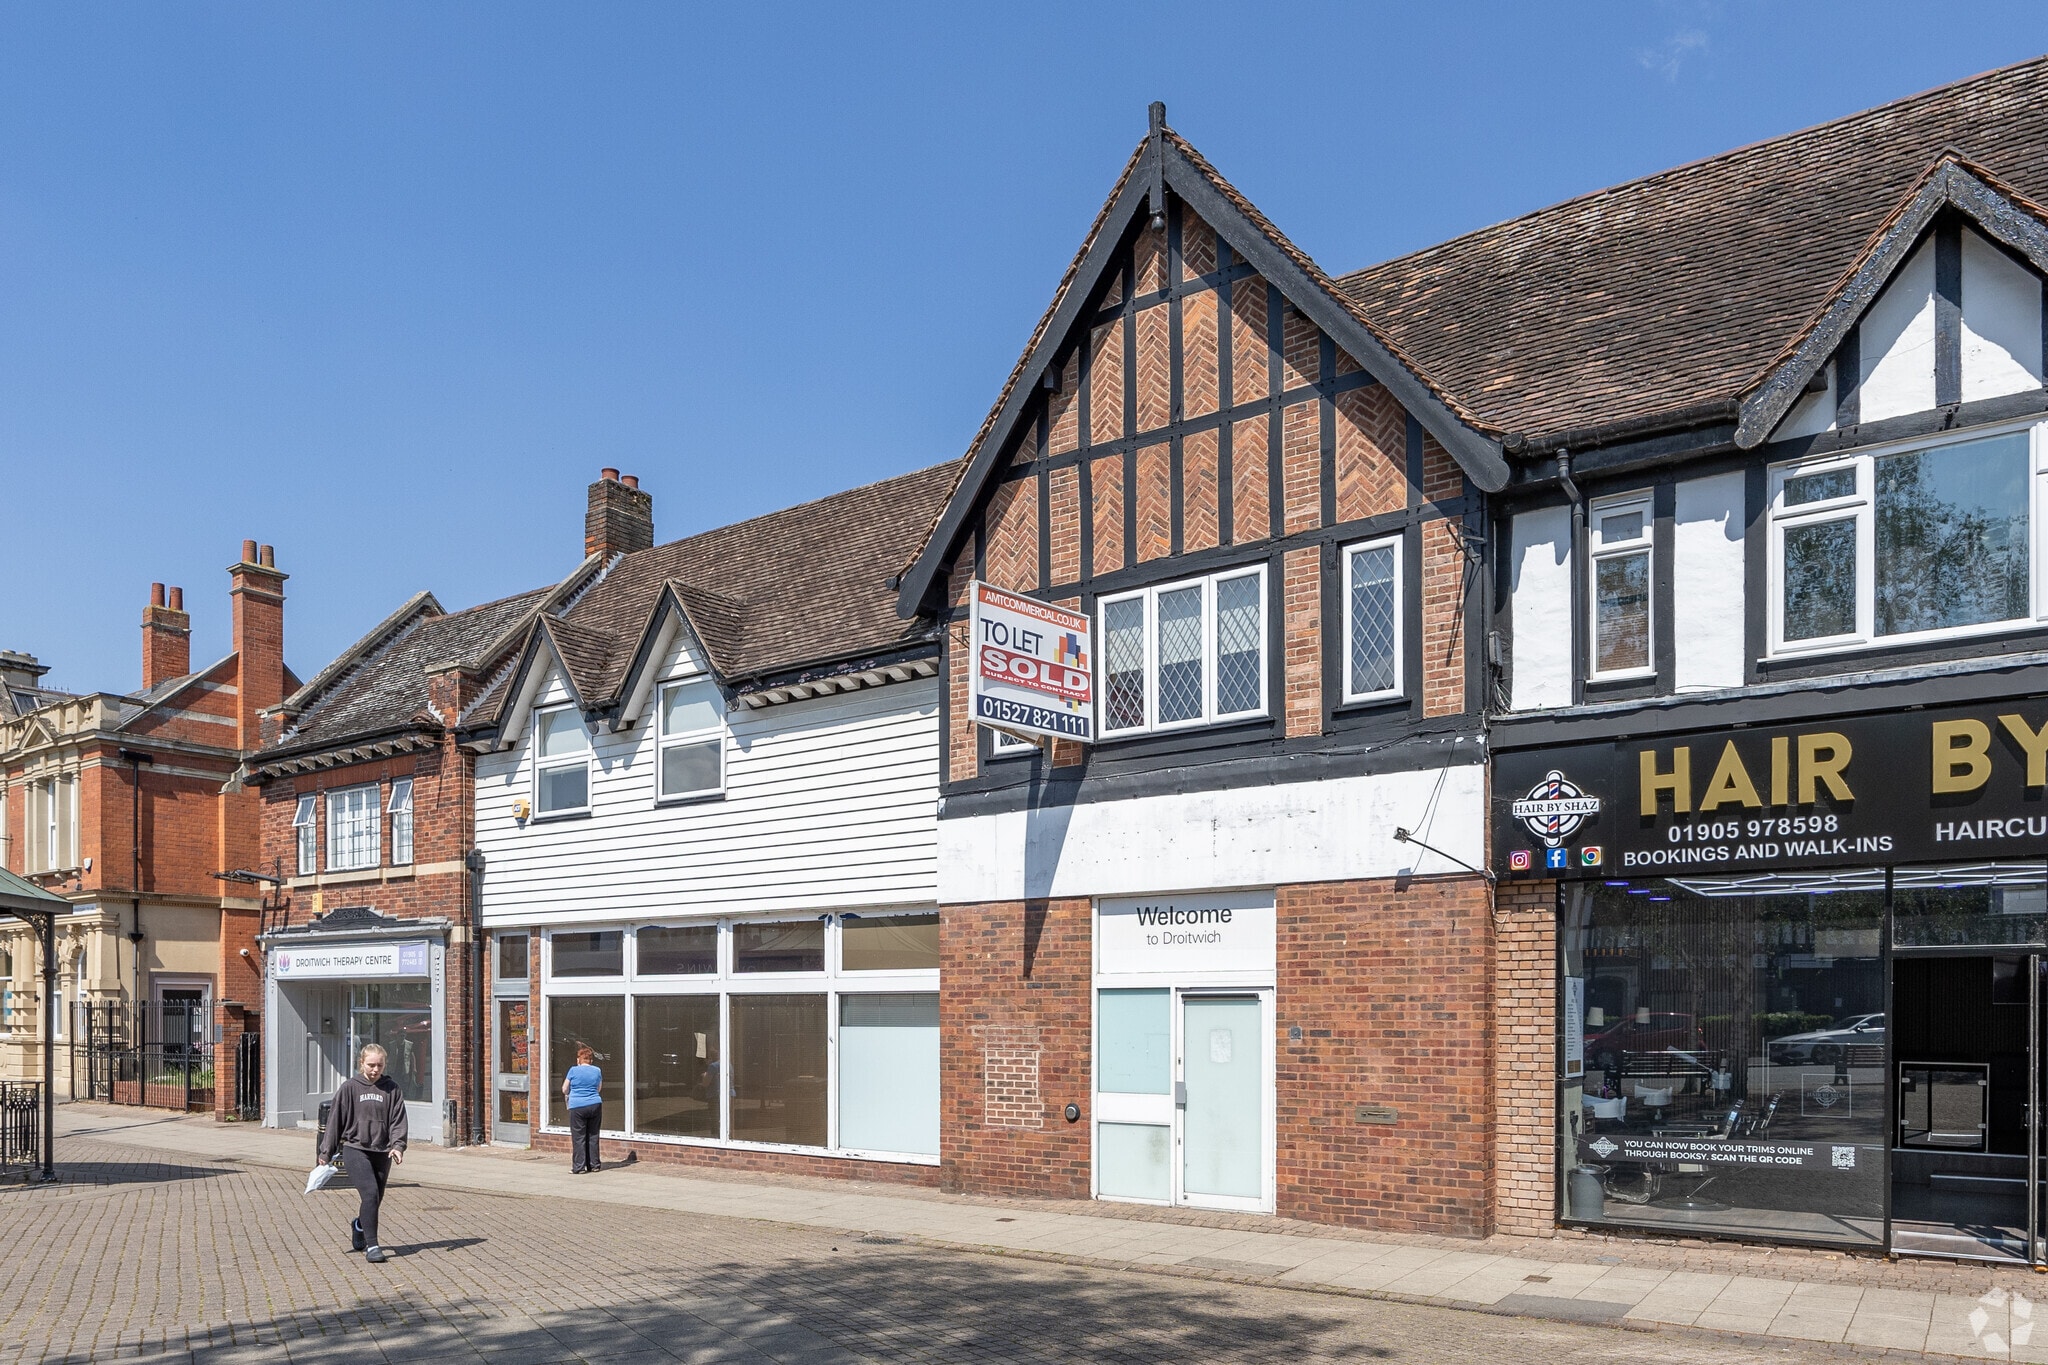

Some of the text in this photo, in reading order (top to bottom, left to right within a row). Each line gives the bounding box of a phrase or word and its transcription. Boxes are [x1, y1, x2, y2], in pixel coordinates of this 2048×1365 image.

[985, 591, 1081, 630] AMTCOMMERCIAL.CO.UK
[980, 618, 1043, 655] TO LET
[982, 649, 1088, 691] SOLD
[985, 670, 1087, 698] SUBJECT TO CONTRACT
[983, 698, 1084, 735] 01527 821 111
[1640, 714, 2048, 816] HAIR BY
[1514, 800, 1598, 813] HAIR BY SHAZ
[1668, 814, 1838, 843] 01905 978598
[1623, 836, 1893, 867] BOOKINGS AND WALK-INS
[1136, 906, 1232, 926] Welcome
[1146, 930, 1221, 945] to Droitwich
[295, 955, 392, 968] DROITWICH THERAPY CENTRE
[1624, 1140, 1643, 1148] YOU
[1644, 1141, 1663, 1149] CAN
[1665, 1142, 1688, 1150] NOW
[1690, 1143, 1717, 1151] BOOK
[1718, 1144, 1744, 1152] YOUR
[1746, 1145, 1775, 1154] TRIMS
[1777, 1146, 1814, 1155] ONLINE
[1624, 1149, 1803, 1165] THROUGH BOOKSY. SCAN THE QR CODE
